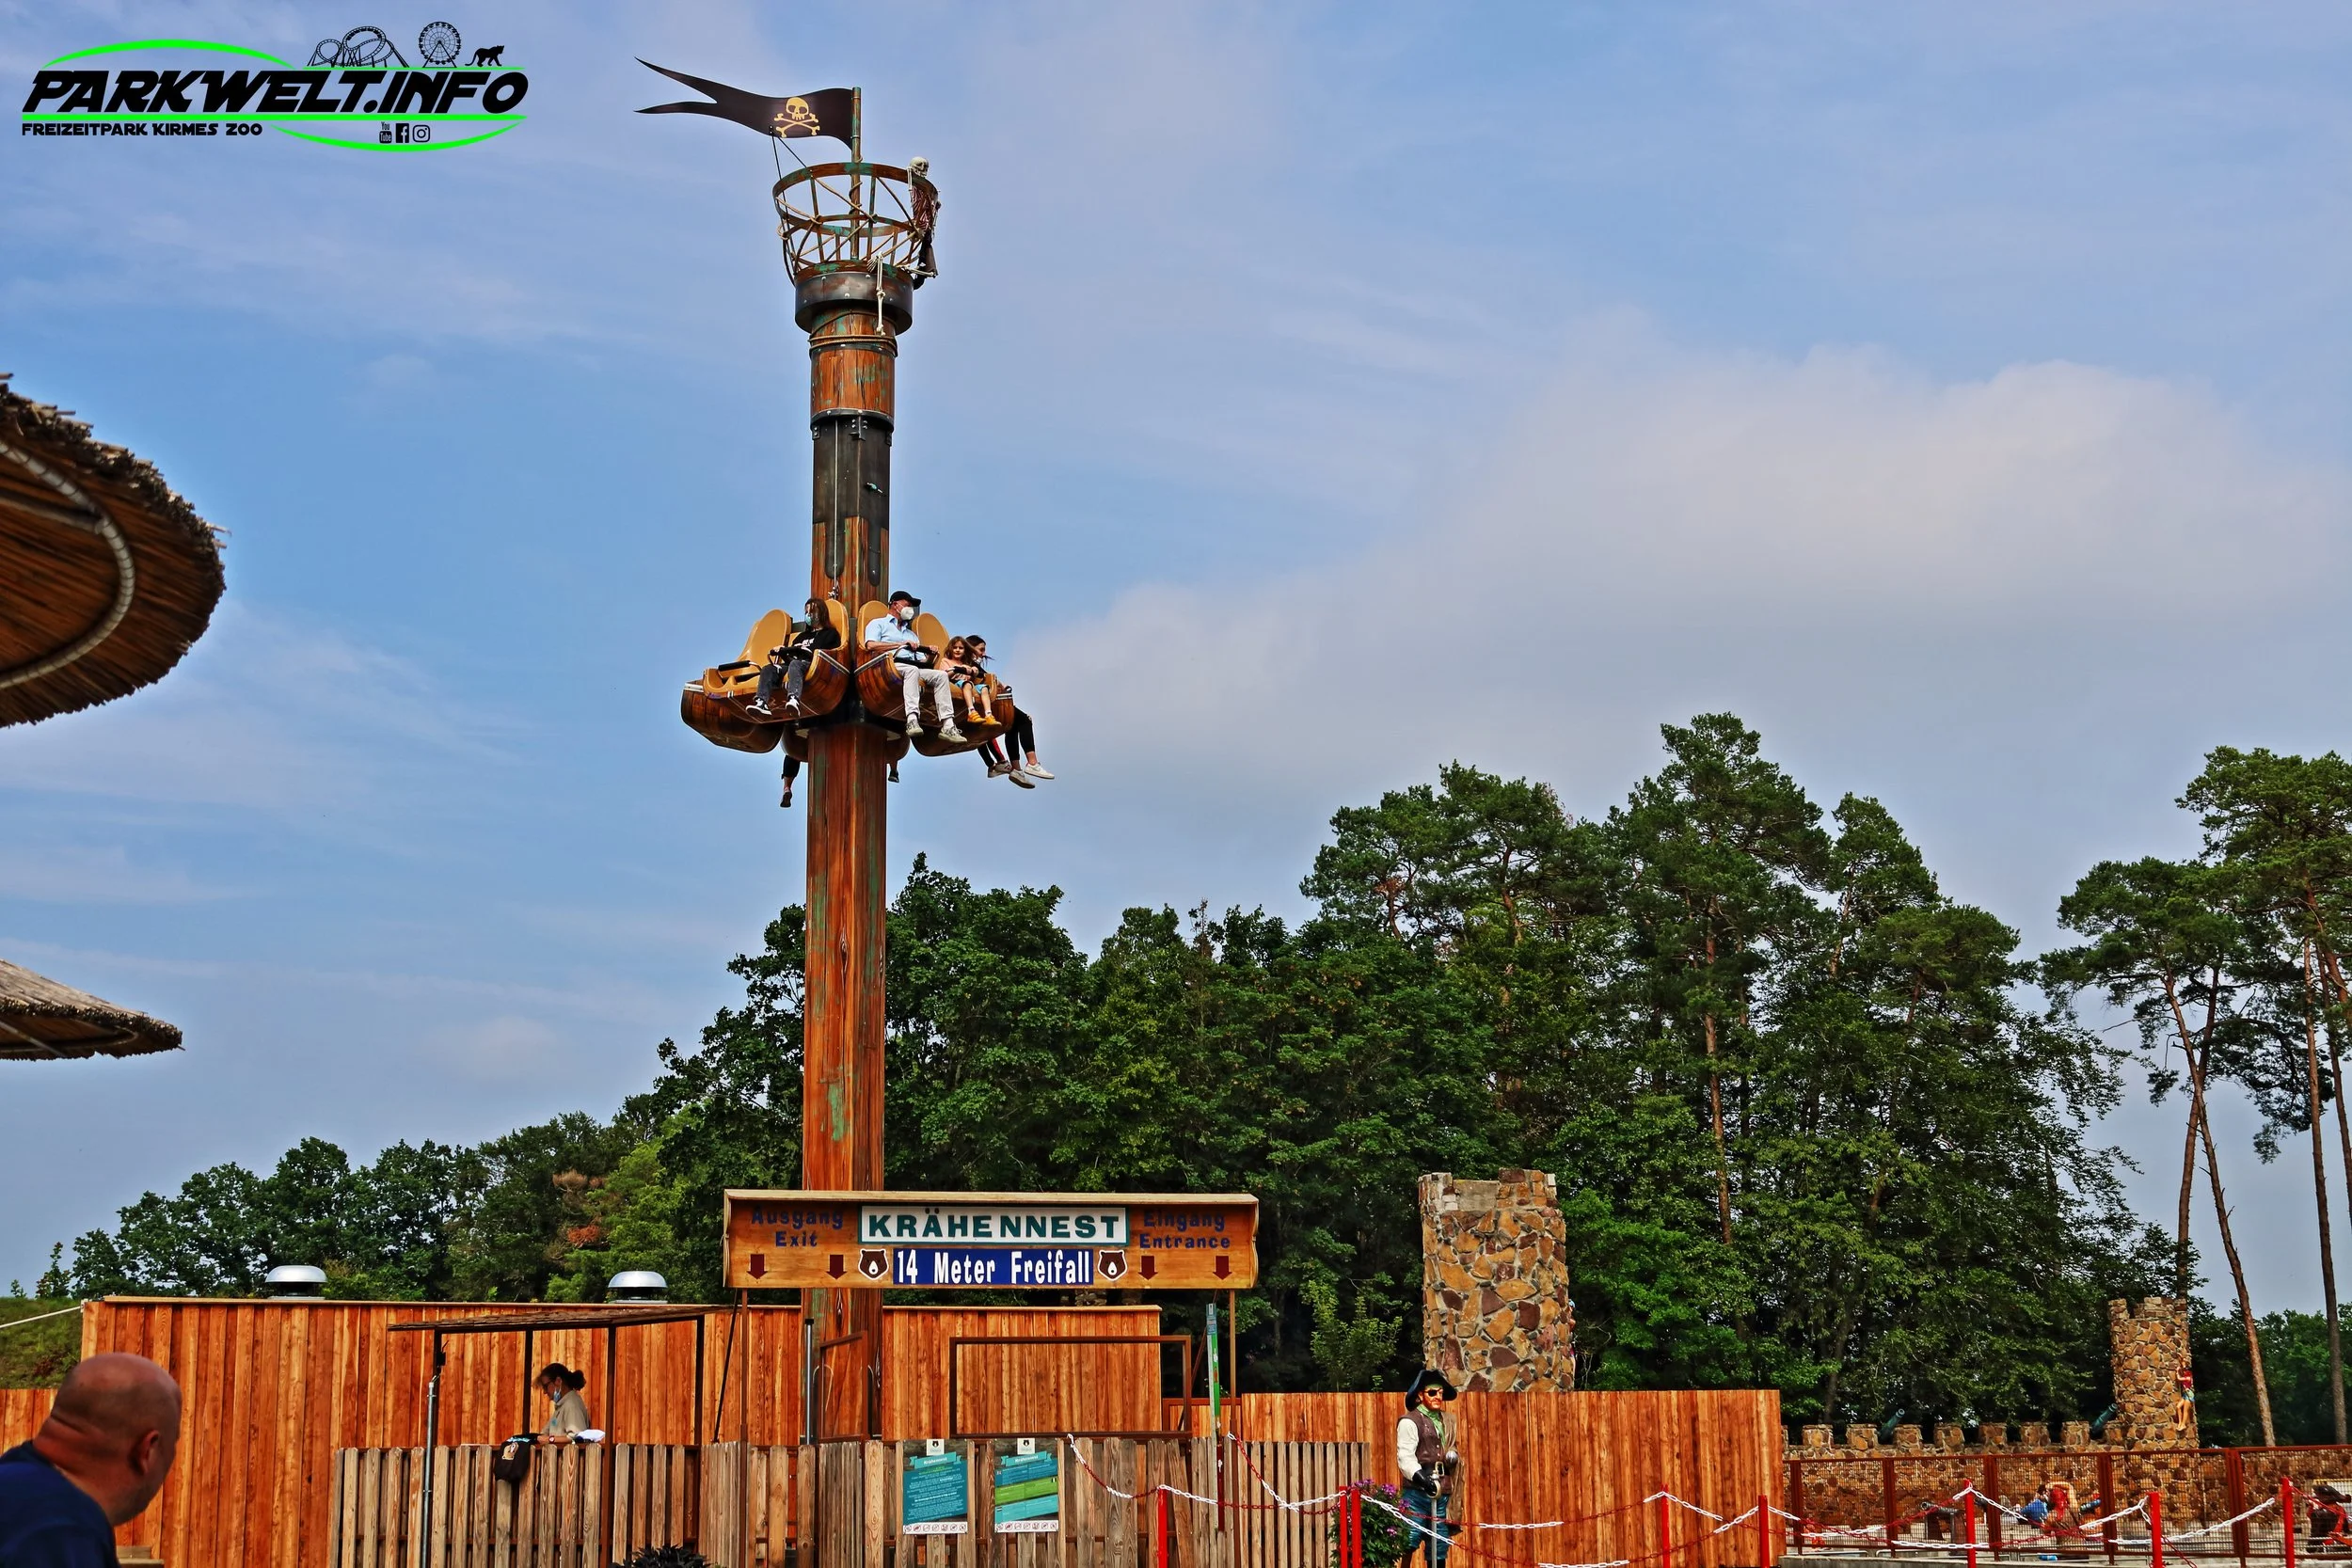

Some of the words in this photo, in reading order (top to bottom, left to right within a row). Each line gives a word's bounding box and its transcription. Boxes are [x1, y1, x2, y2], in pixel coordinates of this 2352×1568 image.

[751, 1208, 844, 1230] Ausgang
[868, 1208, 1120, 1239] KRÄHENNEST
[1143, 1210, 1225, 1232] Eingang
[775, 1230, 818, 1247] Exit
[1139, 1233, 1231, 1249] Entrance
[898, 1249, 918, 1284] 14
[934, 1251, 995, 1284] Meter
[1010, 1249, 1089, 1284] Freifall
